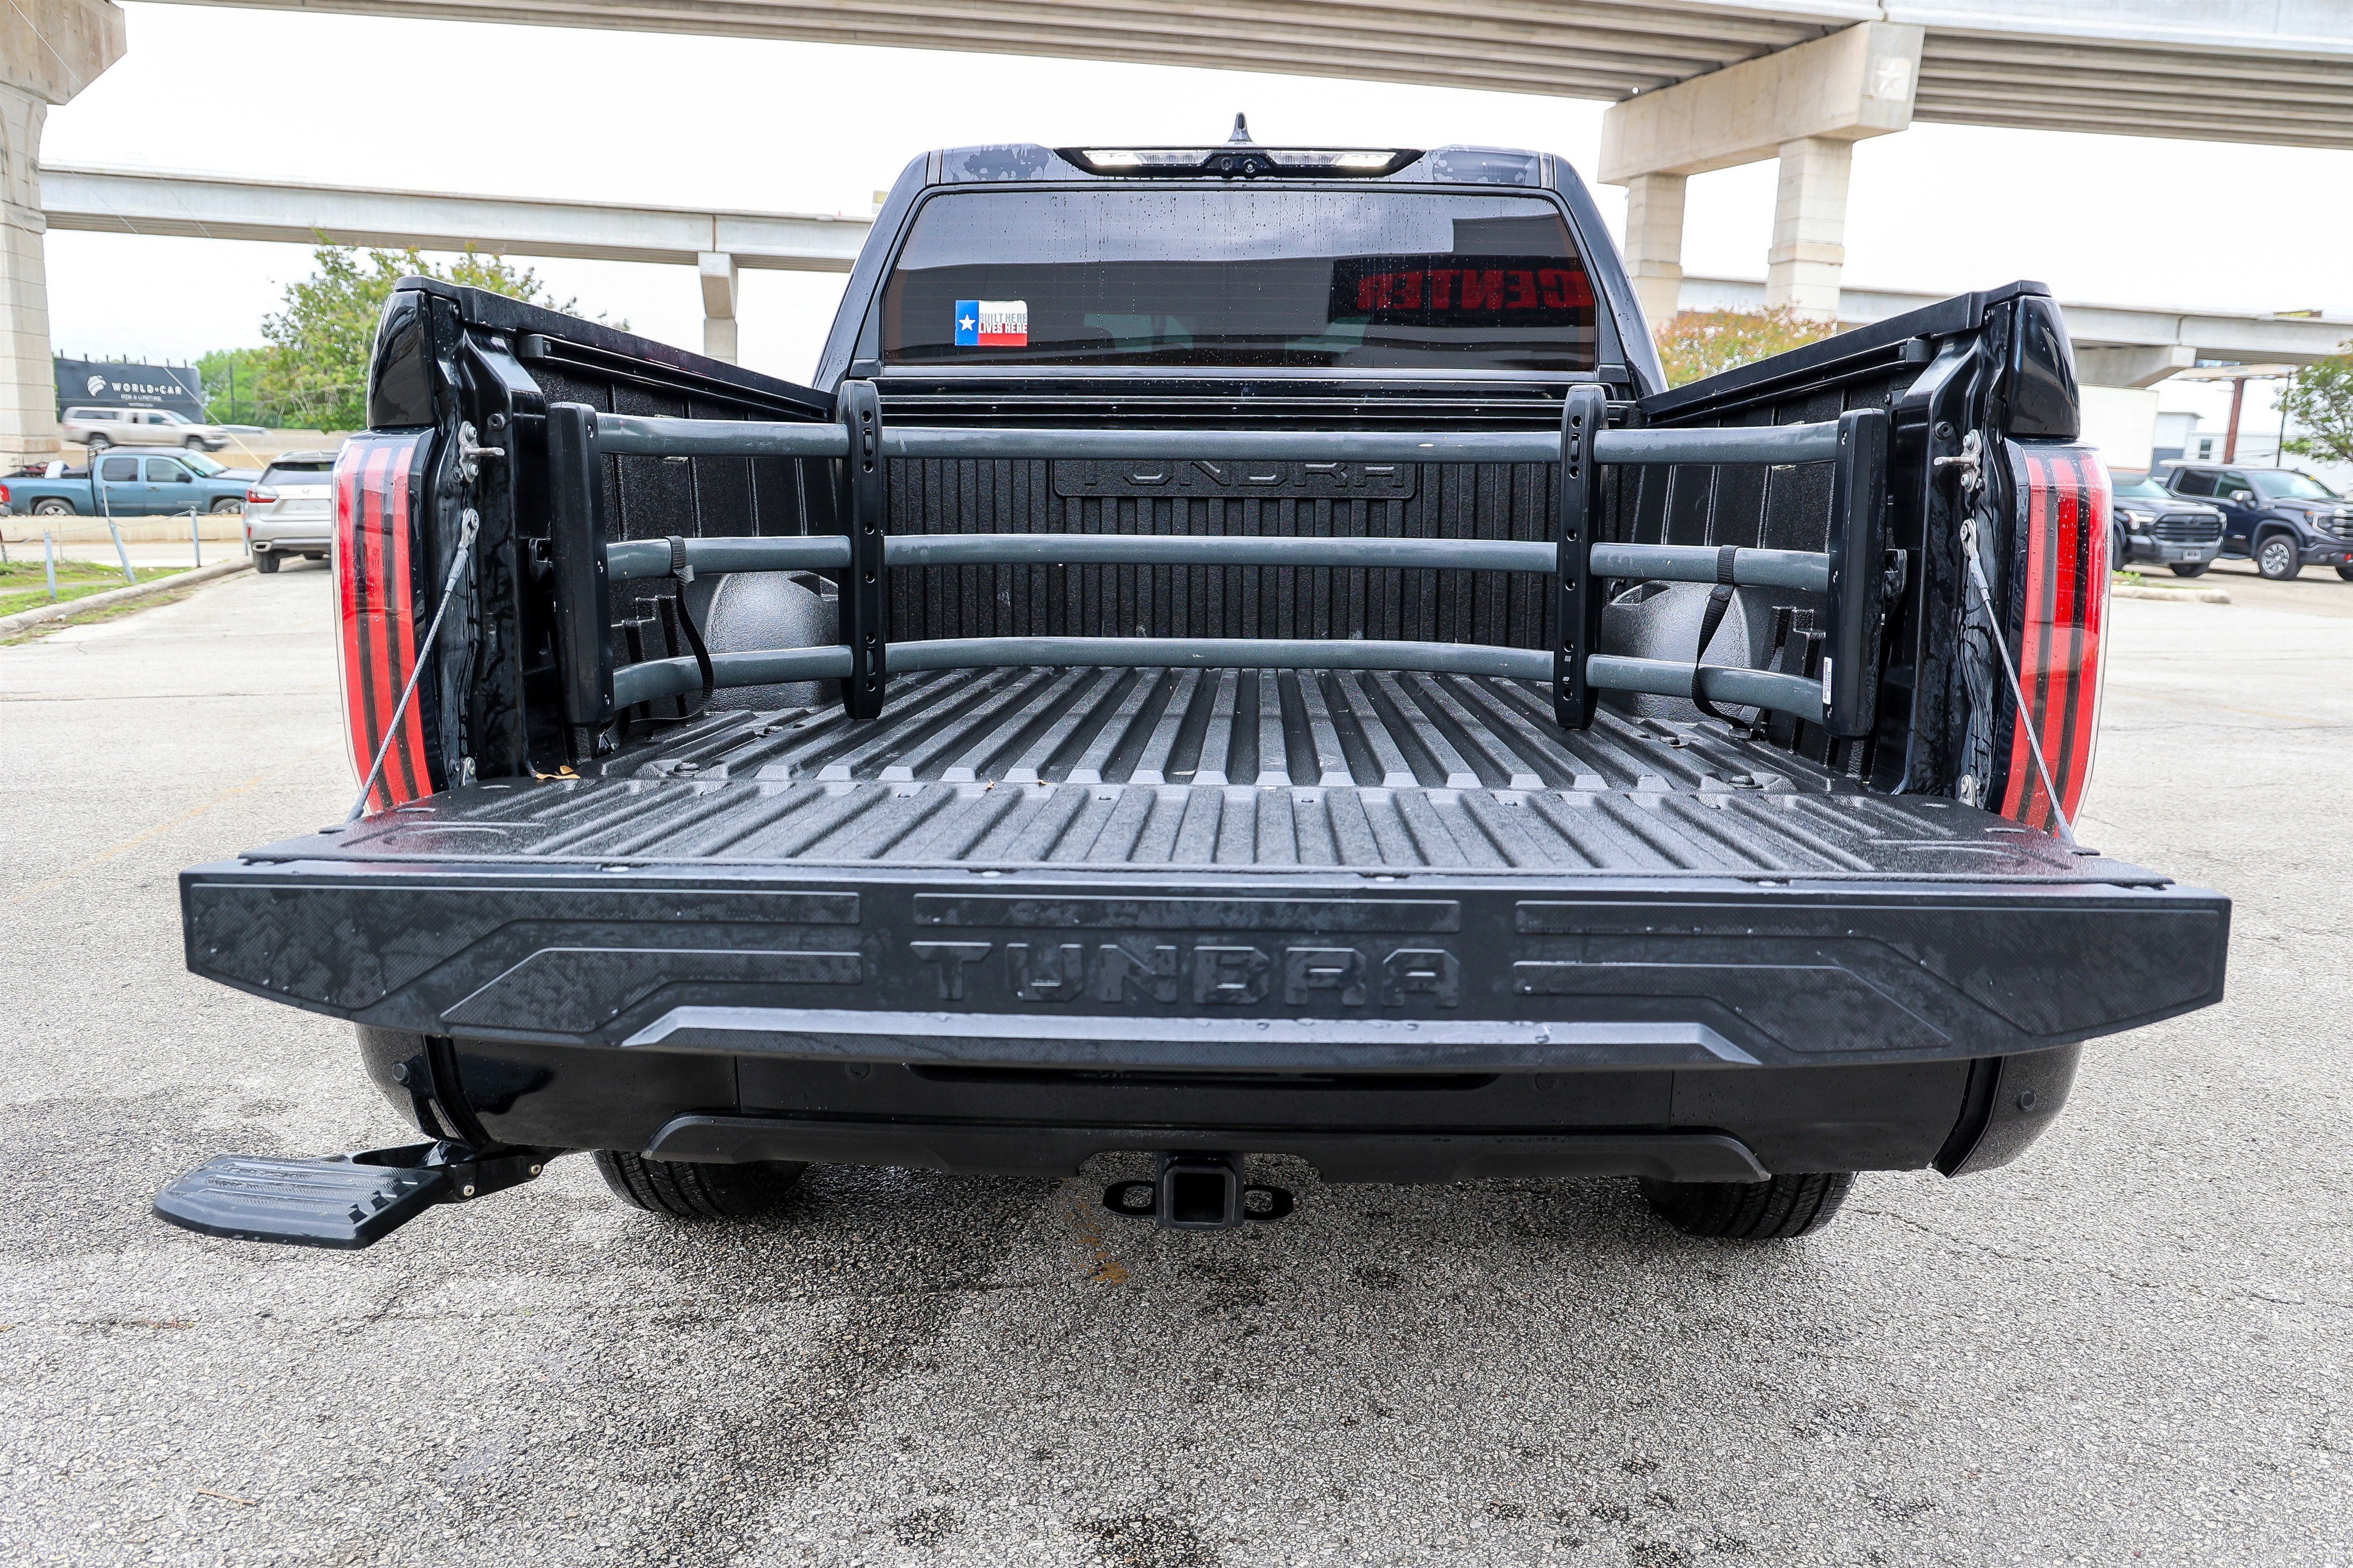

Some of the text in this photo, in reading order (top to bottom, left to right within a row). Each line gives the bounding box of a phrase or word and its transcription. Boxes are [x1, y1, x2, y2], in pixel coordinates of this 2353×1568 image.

[979, 313, 1027, 323] BUILT HERE
[978, 322, 1027, 334] LIVES HERE
[909, 941, 1460, 1007] TUNDRA
